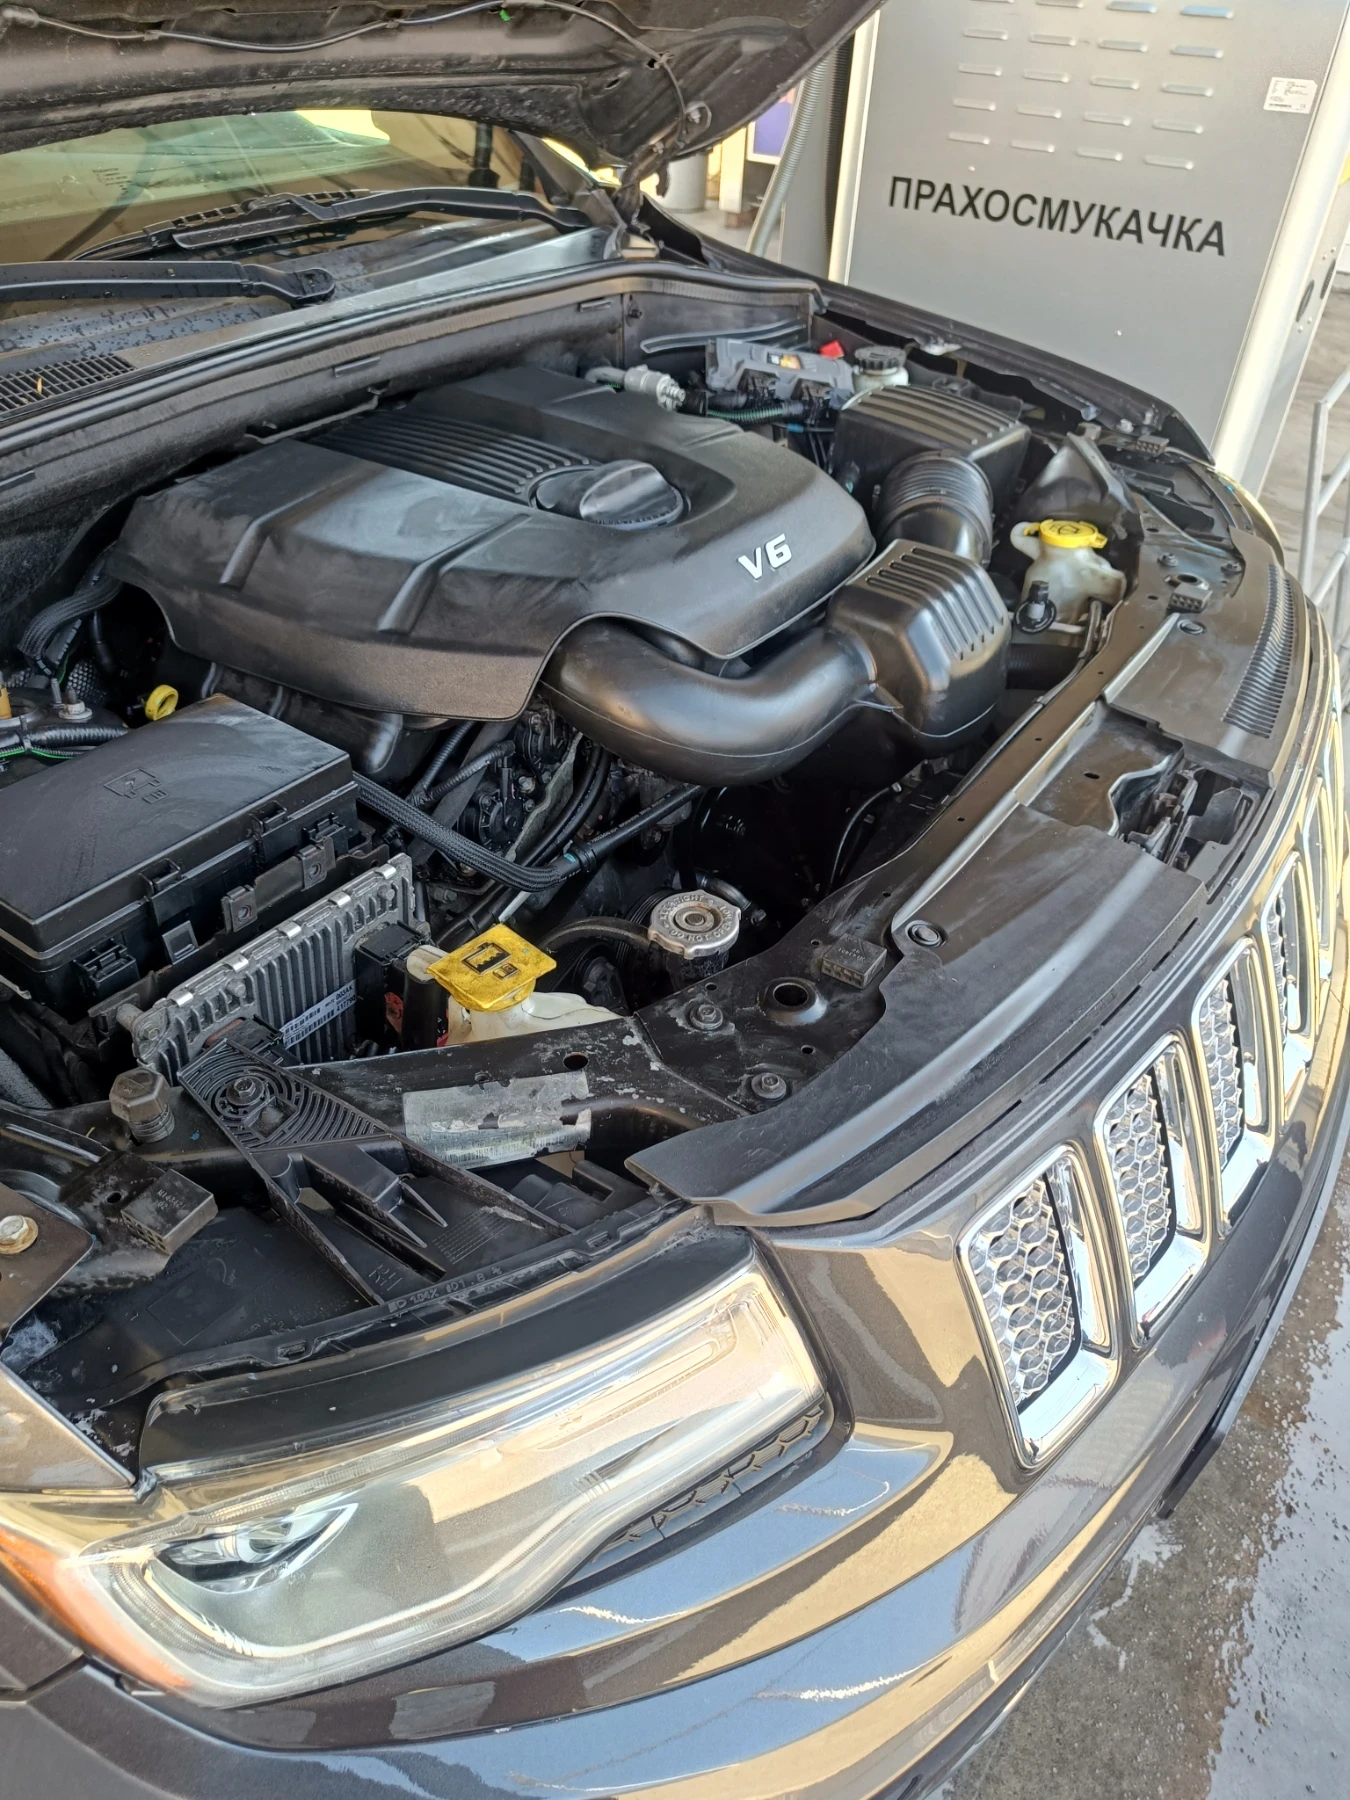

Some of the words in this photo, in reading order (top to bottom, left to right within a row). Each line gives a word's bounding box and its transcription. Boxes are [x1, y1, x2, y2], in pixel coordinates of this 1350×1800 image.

[888, 176, 1226, 257] ПРАХОСМУКАЧКА
[737, 533, 792, 579] V6
[688, 934, 709, 942] NOT
